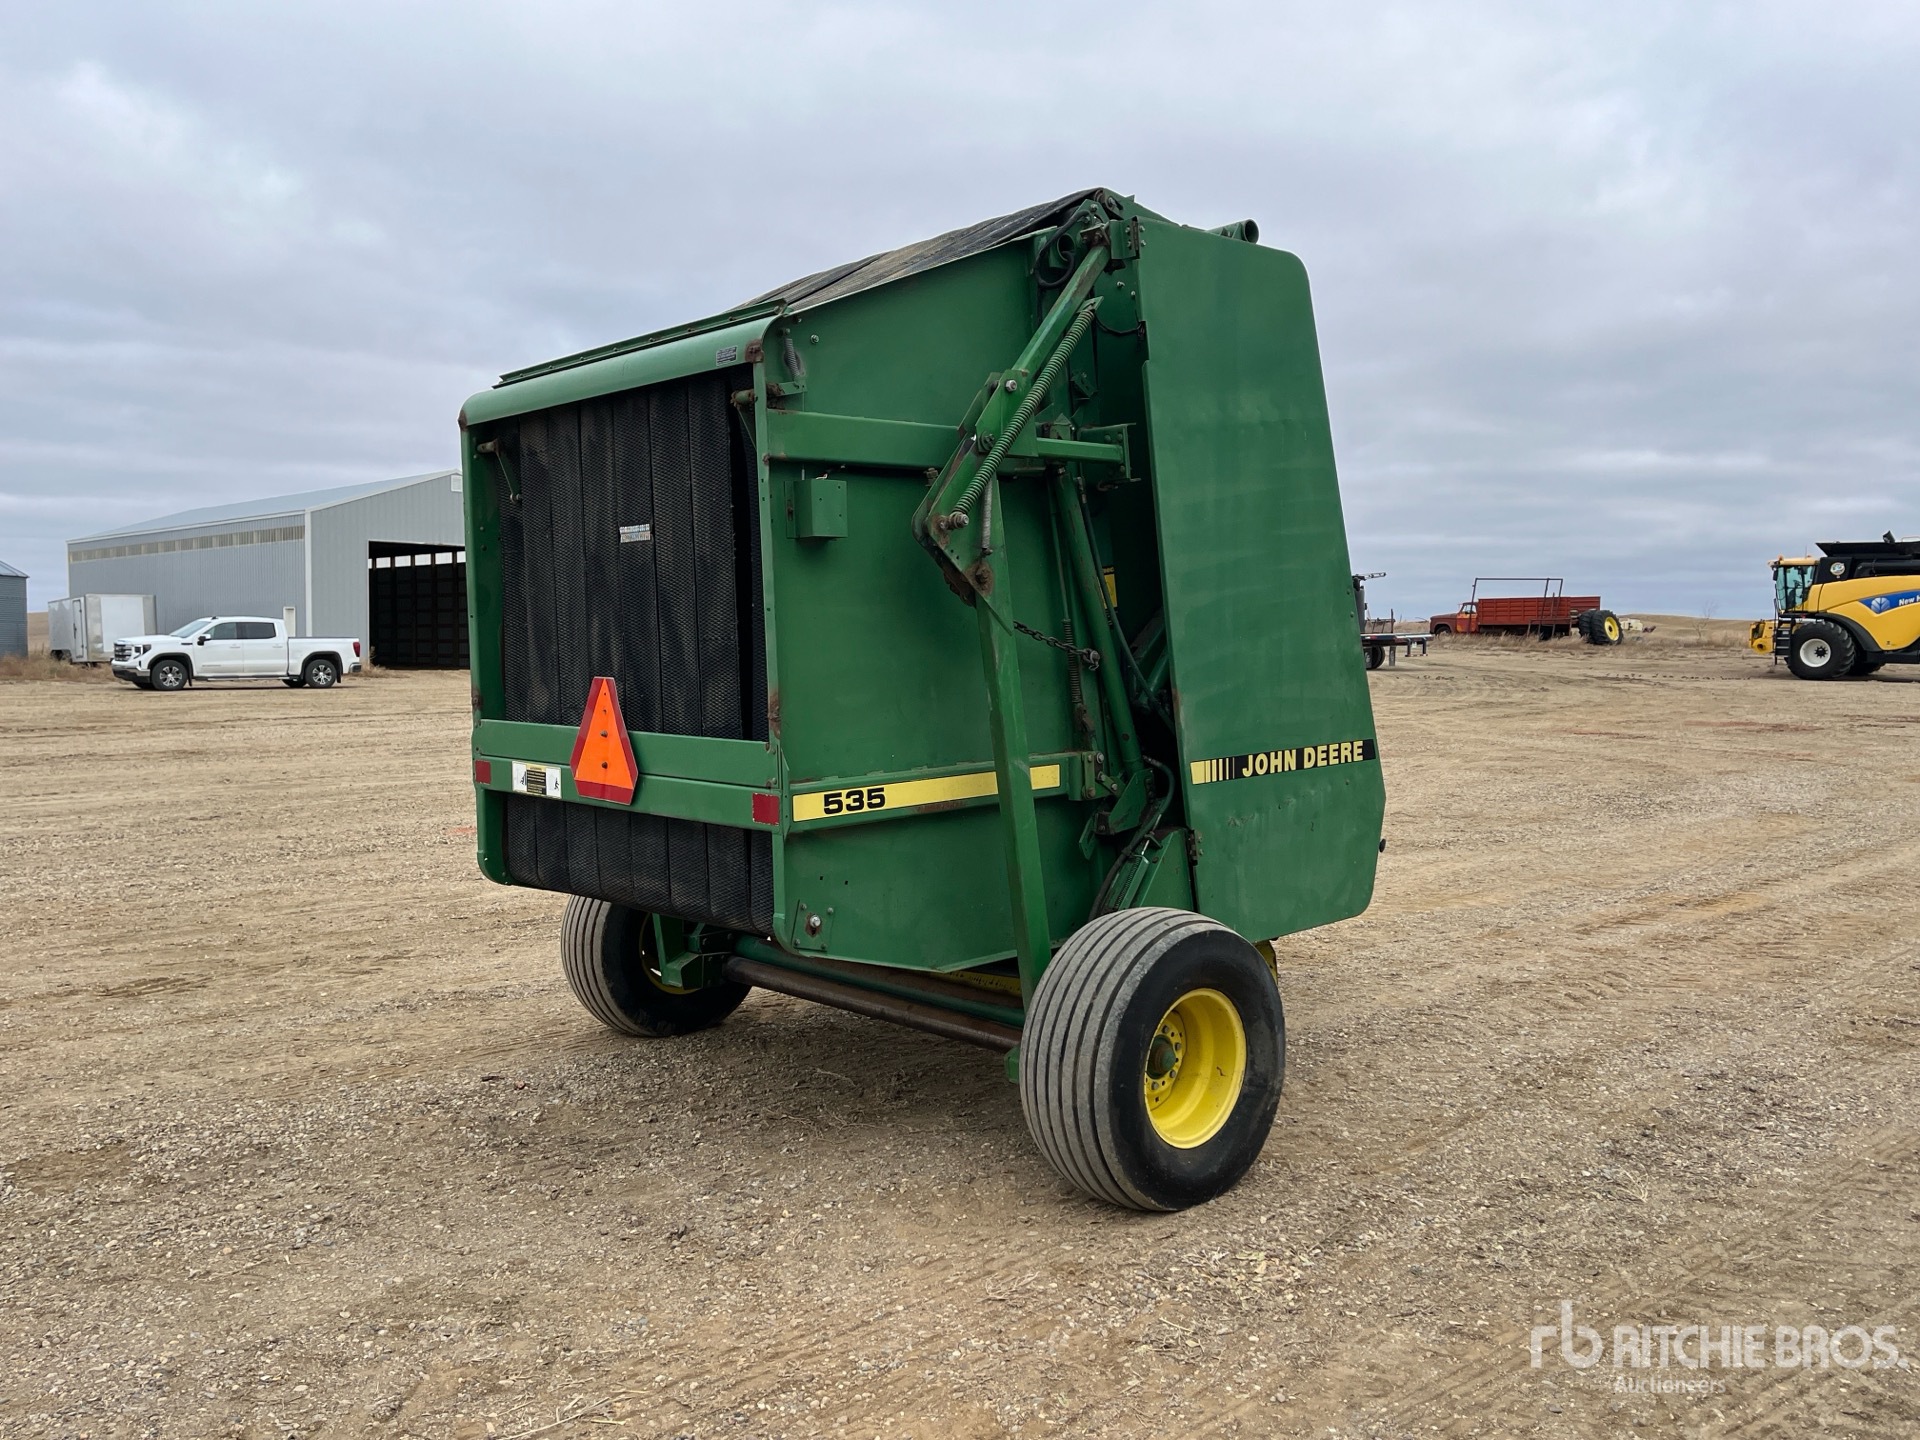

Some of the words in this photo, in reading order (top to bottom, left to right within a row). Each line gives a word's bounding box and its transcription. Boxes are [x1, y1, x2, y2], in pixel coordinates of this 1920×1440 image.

[1899, 597, 1915, 606] New
[1242, 749, 1297, 778] JOHN
[1303, 740, 1364, 770] DEERE
[823, 787, 886, 815] 535
